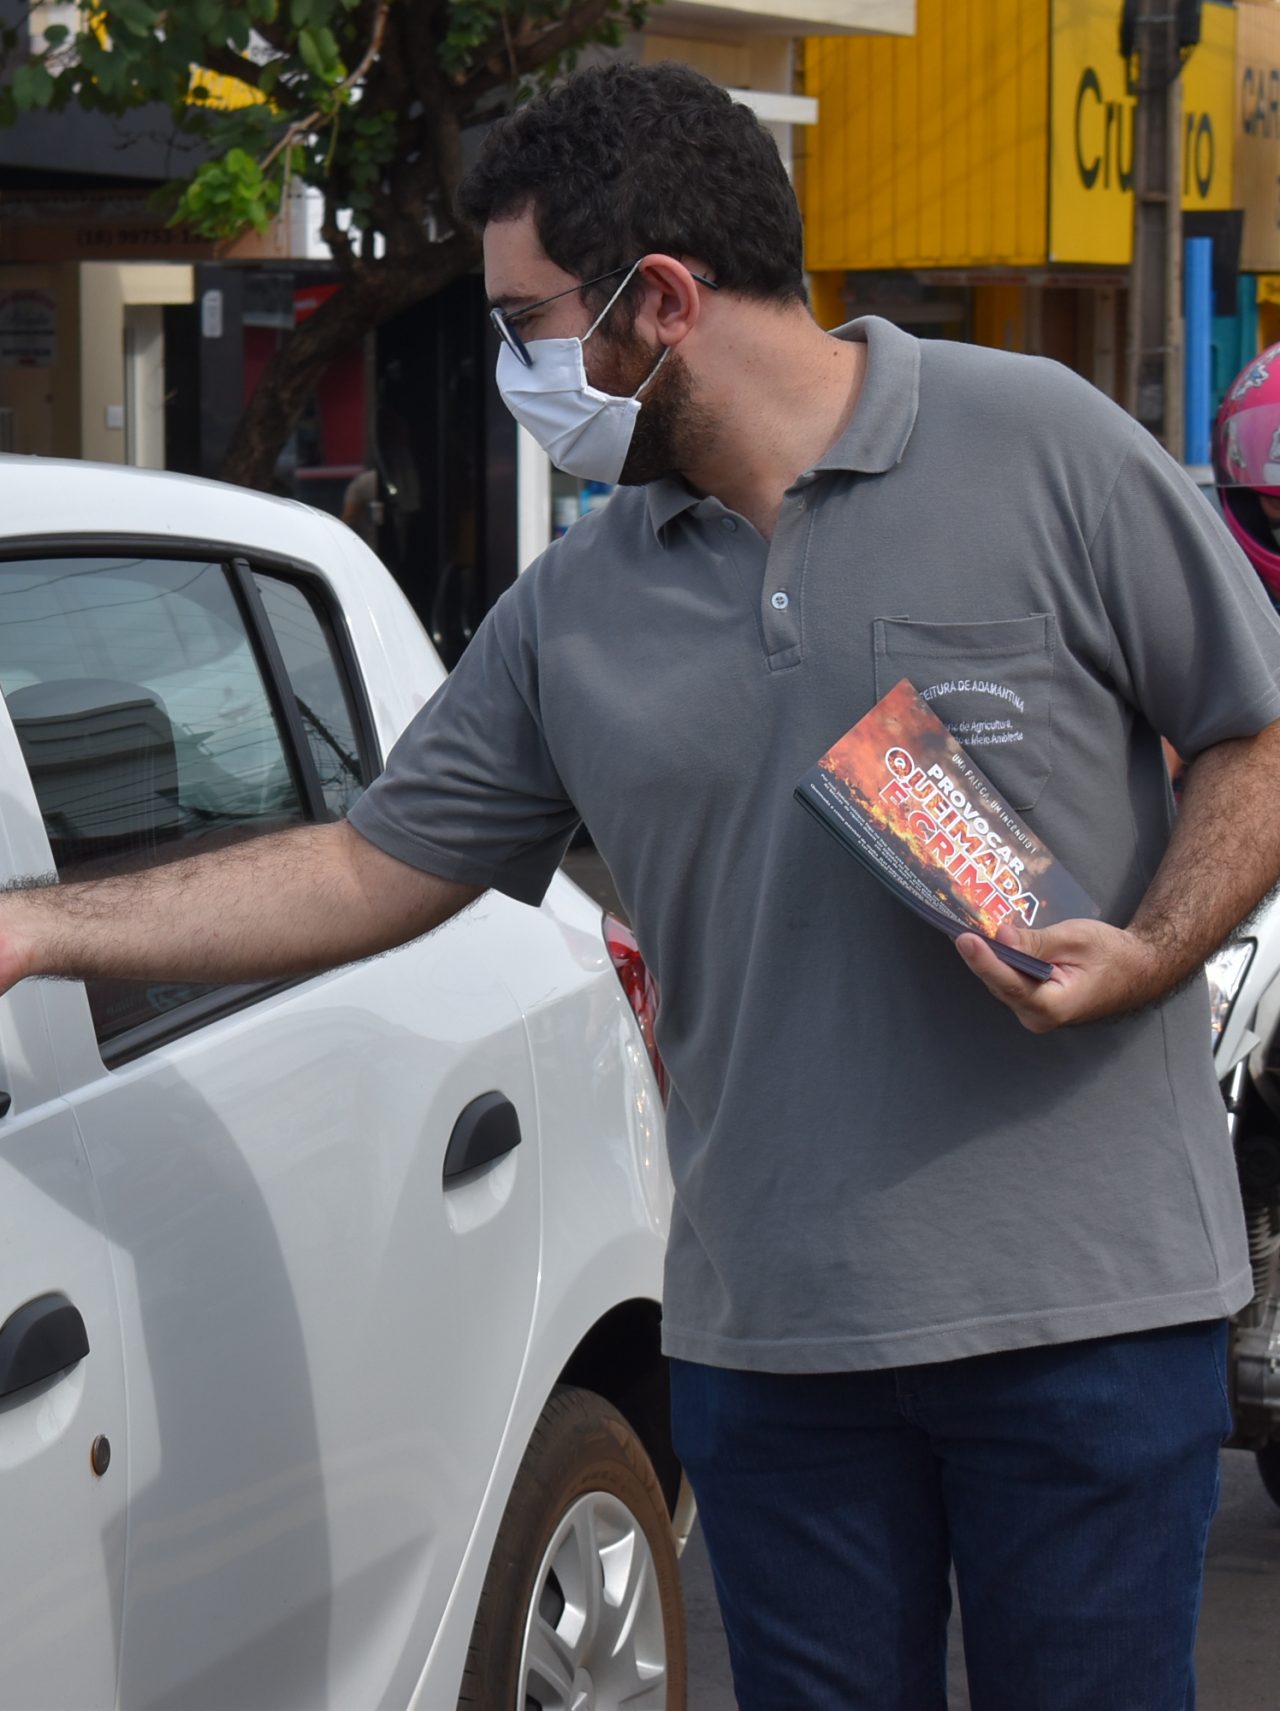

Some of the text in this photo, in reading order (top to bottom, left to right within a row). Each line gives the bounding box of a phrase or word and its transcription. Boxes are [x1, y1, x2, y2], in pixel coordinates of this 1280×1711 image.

[919, 679, 1025, 712] EITURA DE ADAMANTINA
[885, 746, 1039, 927] QUEIMADA
[927, 763, 1025, 876] PROVOCAR
[952, 753, 966, 771] UMA
[990, 801, 1003, 814] UM
[879, 778, 912, 808] É
[908, 810, 1013, 925] CRIME
